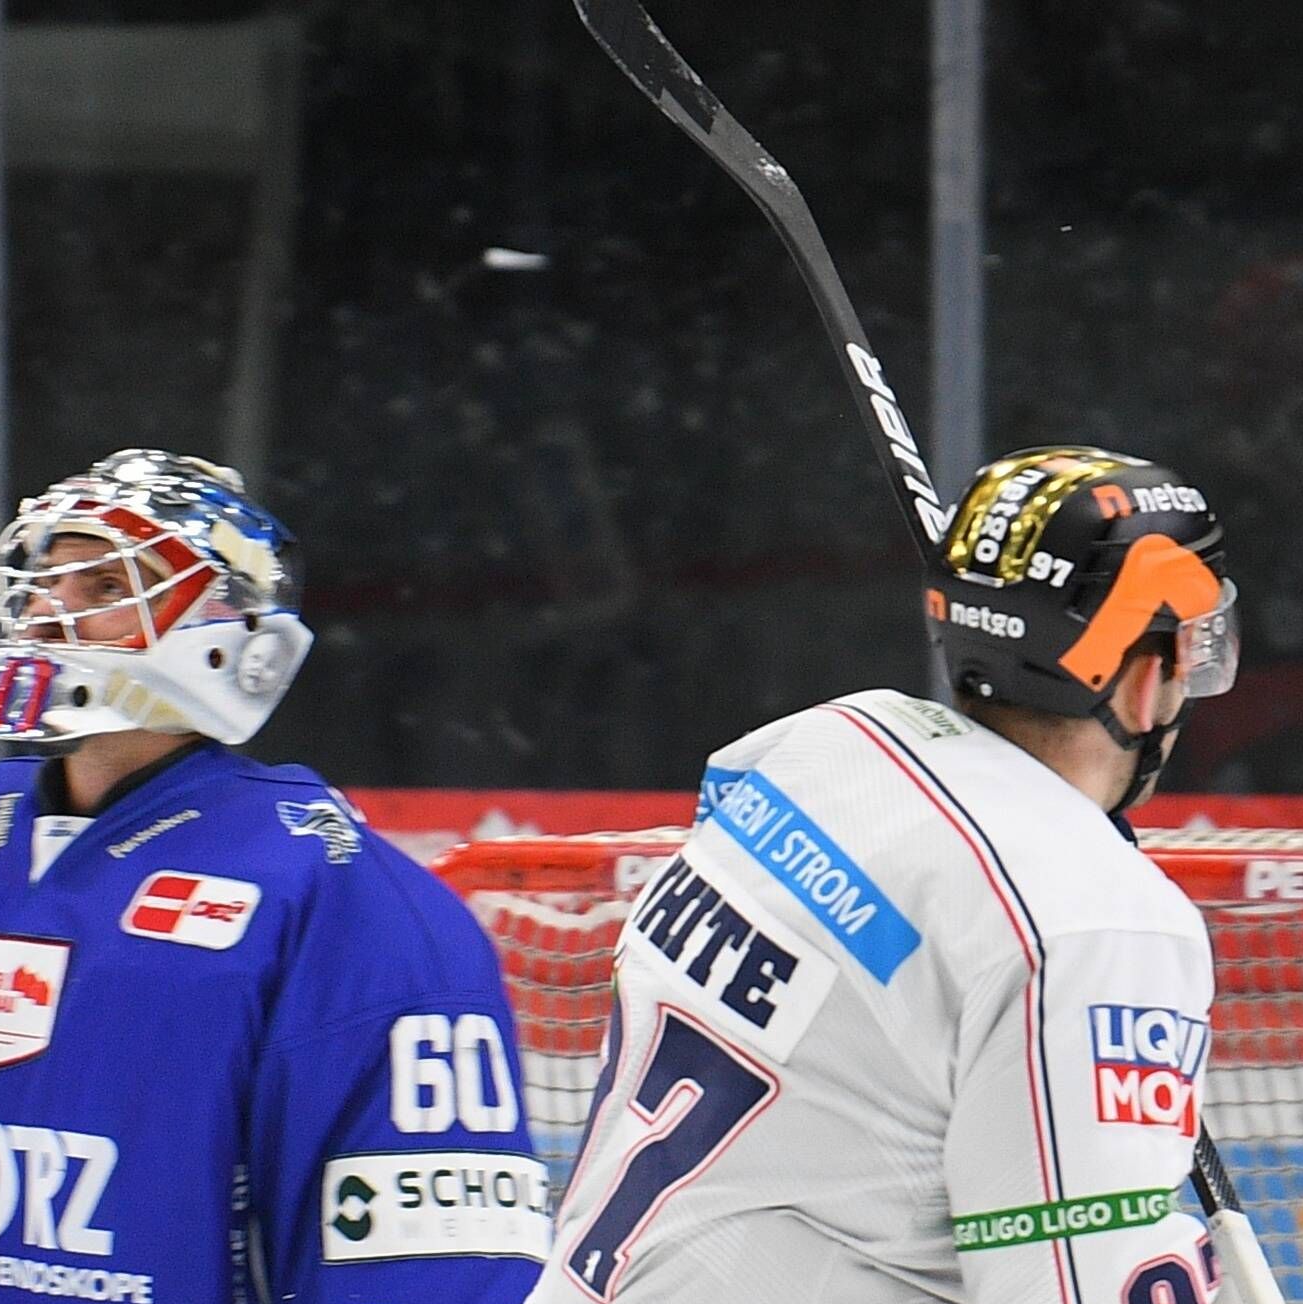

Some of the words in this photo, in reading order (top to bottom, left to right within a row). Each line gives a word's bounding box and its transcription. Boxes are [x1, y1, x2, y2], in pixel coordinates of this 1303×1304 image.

[1027, 550, 1075, 588] 97
[950, 601, 1026, 639] netgo
[770, 829, 878, 935] STROM
[390, 1013, 520, 1133] 60
[980, 1213, 1035, 1243] LIGO
[1041, 1201, 1112, 1234] LIGO
